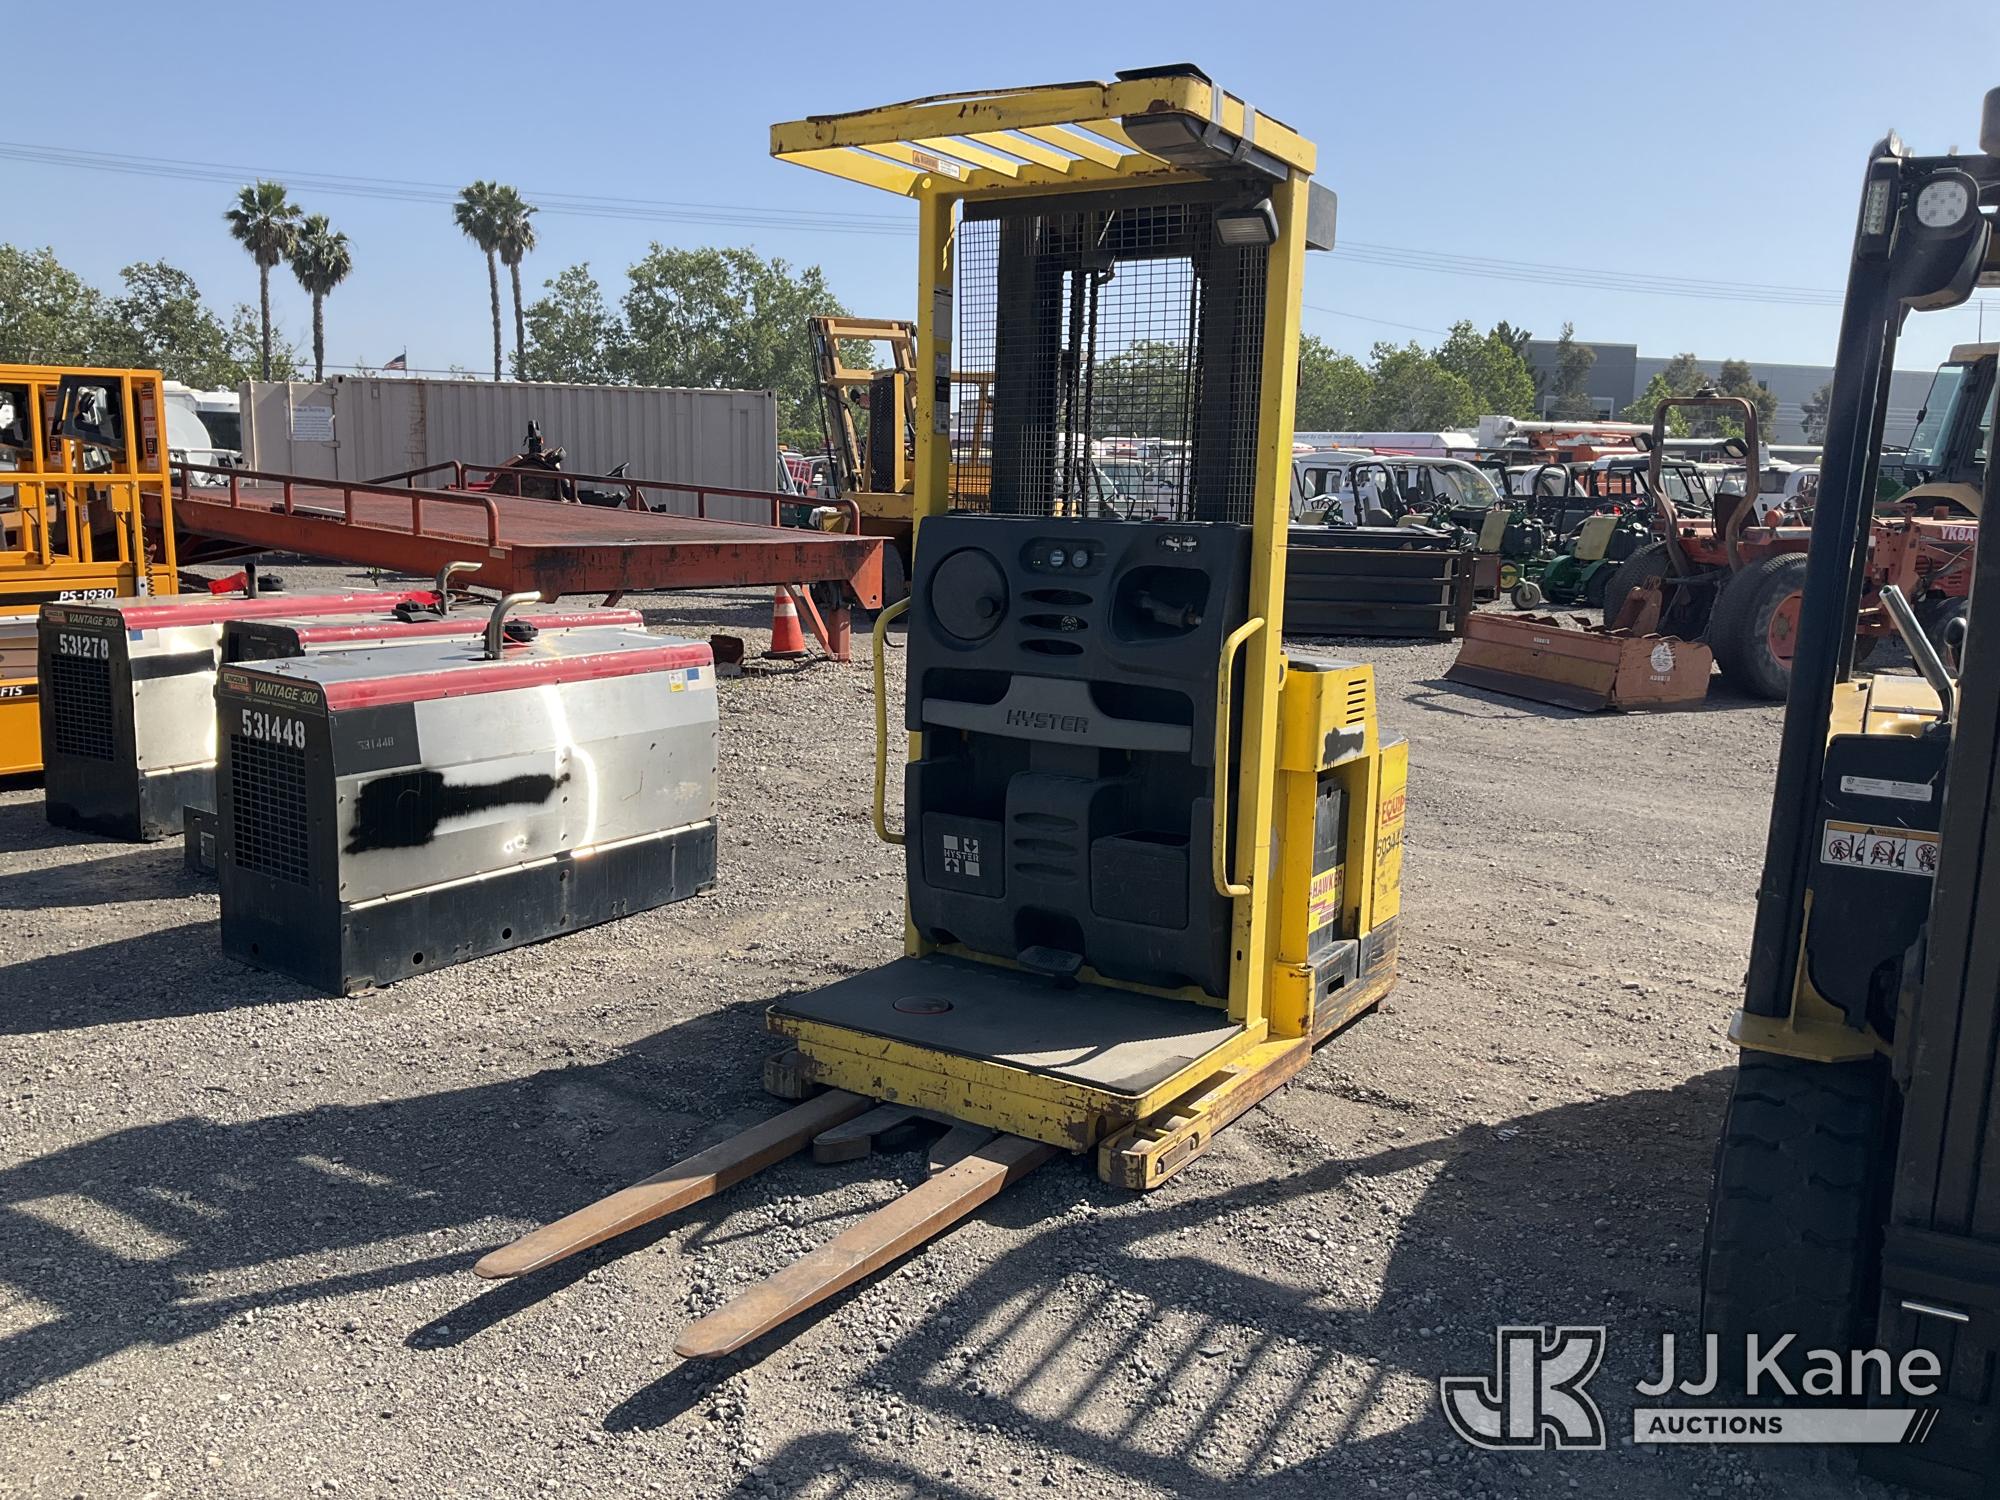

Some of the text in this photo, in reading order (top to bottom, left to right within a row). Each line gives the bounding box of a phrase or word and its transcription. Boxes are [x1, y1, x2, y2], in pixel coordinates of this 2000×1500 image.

[59, 588, 114, 601] PS-1930
[69, 613, 104, 626] VANTAGE
[104, 617, 119, 628] 300
[59, 633, 110, 659] 531278
[254, 680, 300, 701] VANTAGE
[300, 691, 319, 705] 300
[242, 708, 306, 750] 531448
[1006, 709, 1089, 733] HYSTER
[943, 848, 979, 862] HYSTER
